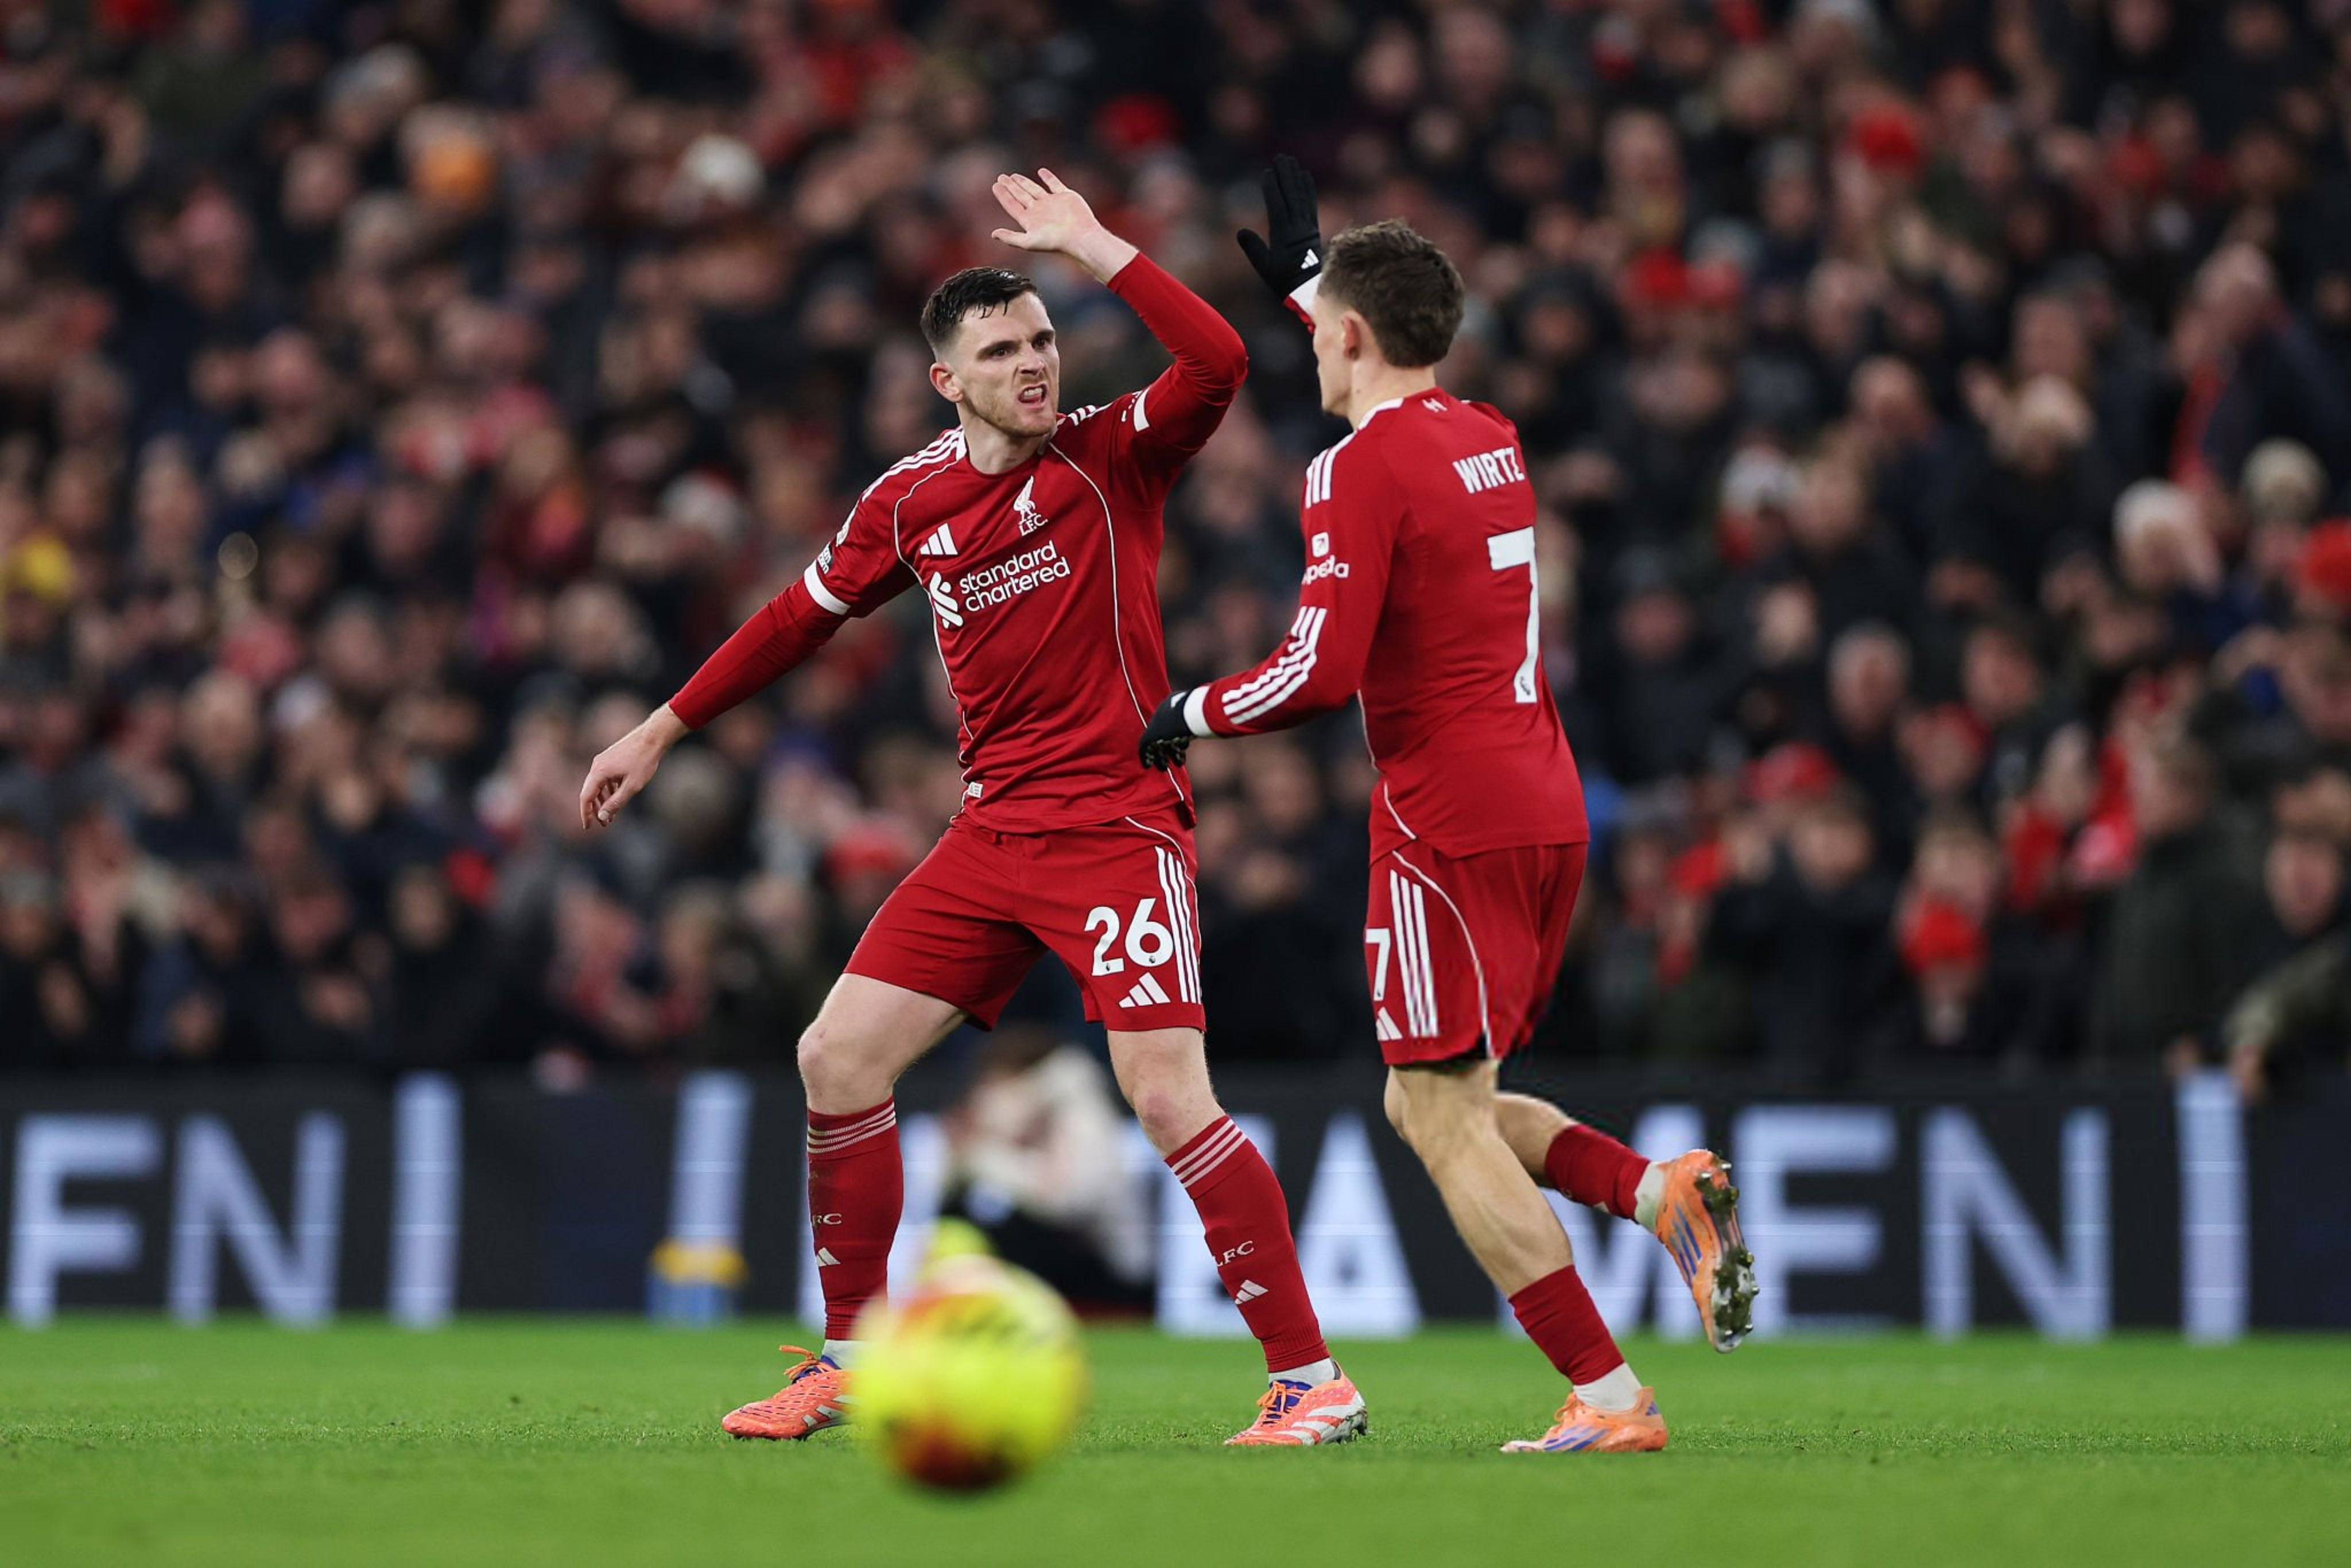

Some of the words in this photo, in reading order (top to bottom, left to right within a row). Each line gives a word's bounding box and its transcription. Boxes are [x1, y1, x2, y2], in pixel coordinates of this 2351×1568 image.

[1452, 447, 1525, 494] WIRTZ
[959, 540, 1057, 595] standard
[965, 556, 1071, 612] chartered
[1487, 526, 1539, 704] 7
[1084, 897, 1174, 976] 26
[1365, 927, 1391, 1002] 7
[812, 1213, 843, 1227] FC
